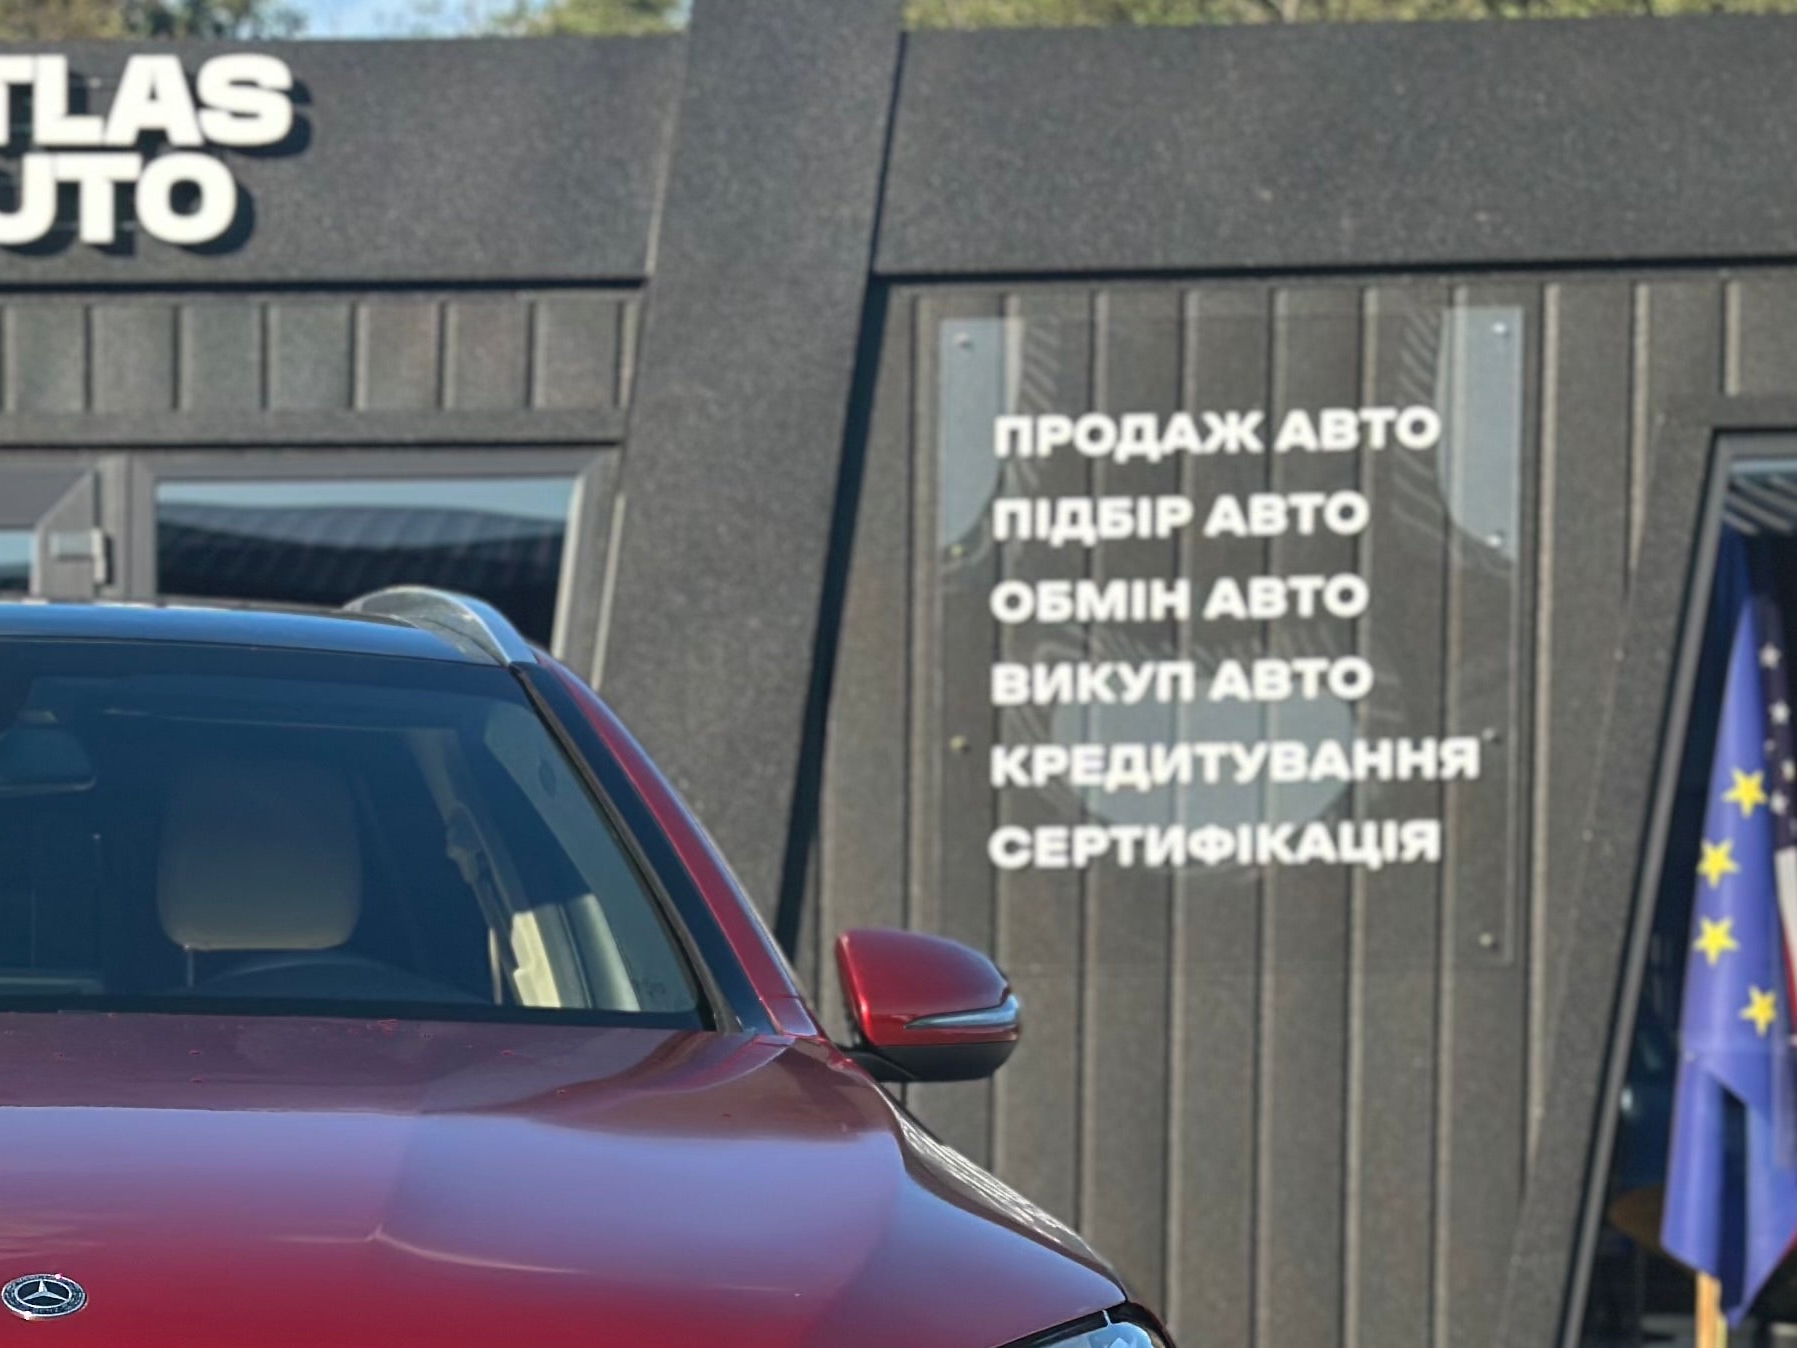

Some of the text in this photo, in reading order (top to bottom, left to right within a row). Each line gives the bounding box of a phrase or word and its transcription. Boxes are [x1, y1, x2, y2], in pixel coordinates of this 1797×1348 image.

[994, 406, 1442, 464] ПРОДАЖ АВТО
[994, 492, 1369, 545] ПІДБІР АВТО
[991, 574, 1368, 622] ОБМІН АВТО
[992, 657, 1373, 704] ВИКУП АВТО
[991, 740, 1478, 790] КРЕДИТУВАННЯ
[990, 821, 1439, 868] СЕРТИФІКАЦІЯ
